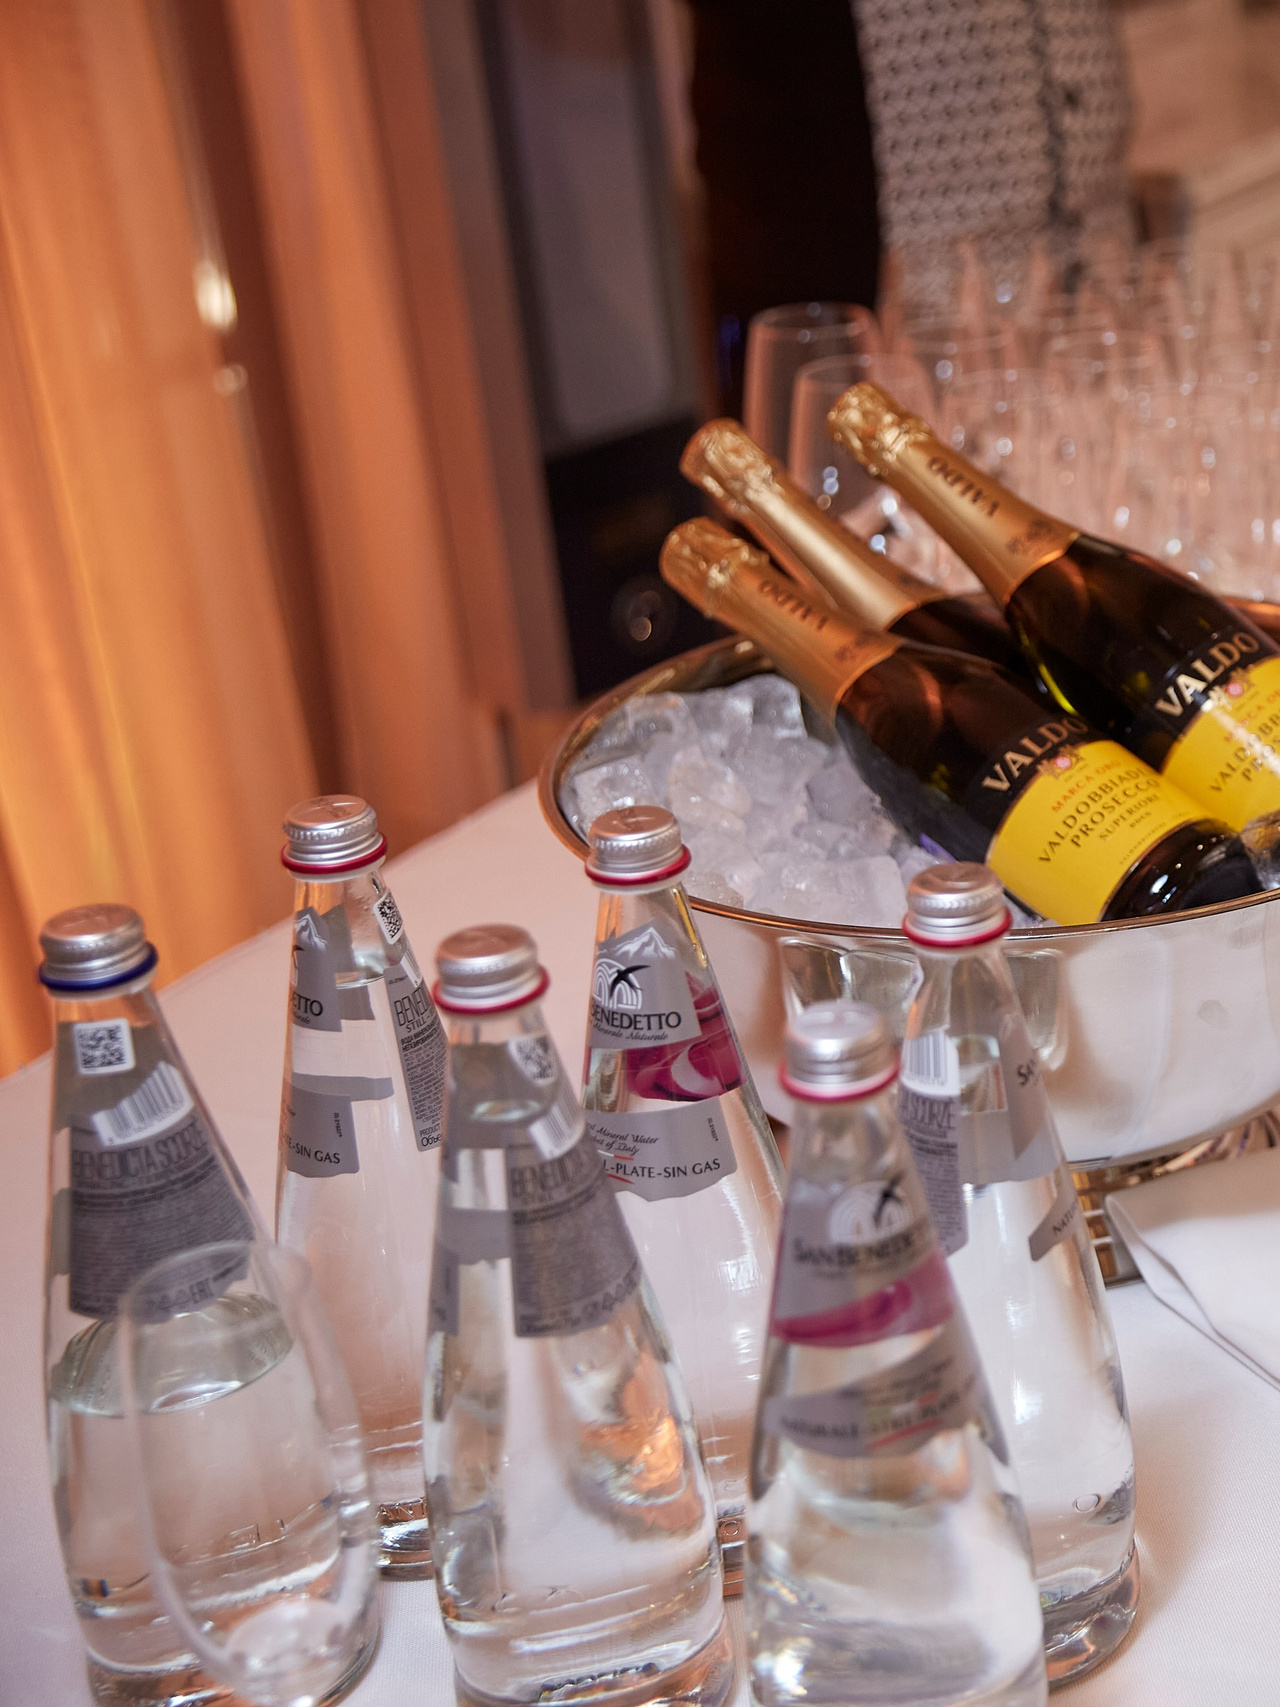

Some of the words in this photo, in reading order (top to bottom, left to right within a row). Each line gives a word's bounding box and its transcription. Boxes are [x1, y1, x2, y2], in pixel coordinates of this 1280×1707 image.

[1156, 632, 1259, 717] VALDO
[982, 718, 1089, 791] VALDO
[1070, 777, 1160, 848] PROSECCO
[596, 1126, 629, 1141] Mineral
[632, 1132, 660, 1144] Water
[314, 1150, 341, 1164] GAS
[616, 1142, 640, 1156] Italy
[691, 1158, 721, 1176] GAS
